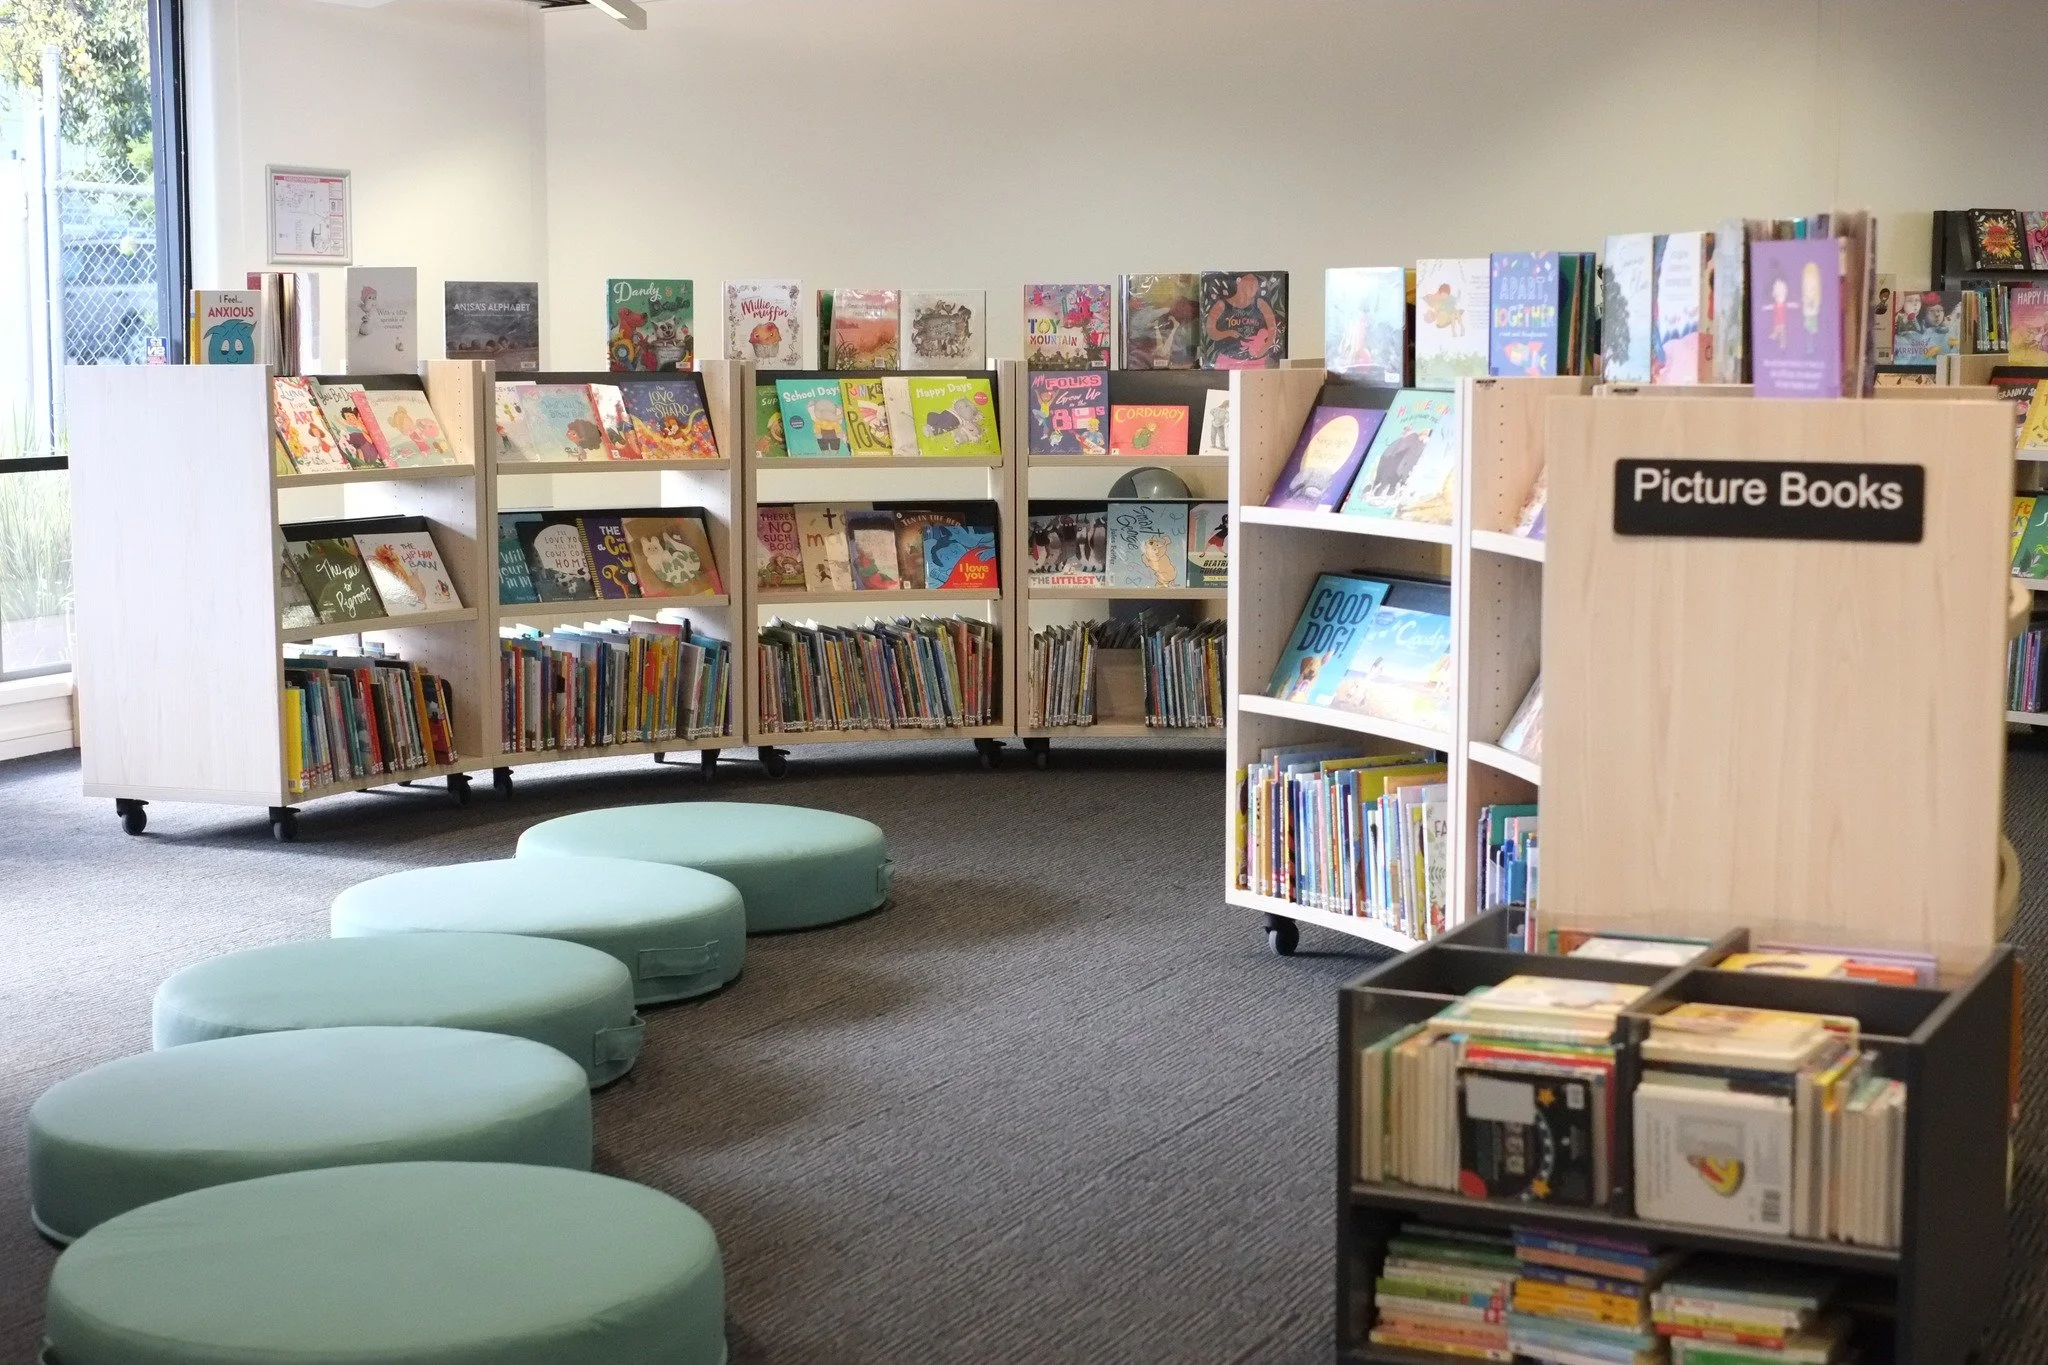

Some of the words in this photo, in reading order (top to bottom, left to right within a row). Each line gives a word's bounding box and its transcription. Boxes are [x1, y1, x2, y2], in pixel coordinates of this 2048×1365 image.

[613, 281, 662, 303] Dandy
[2017, 290, 2042, 305] HAPPY
[207, 306, 254, 318] ANXIOUS
[453, 303, 486, 311] ANISA'S
[488, 304, 531, 312] ALPHABET
[741, 299, 771, 315] Millie
[753, 306, 788, 322] muffin
[1027, 317, 1061, 335] TOY
[1046, 374, 1102, 391] FOLKS
[782, 389, 816, 403] School
[915, 387, 946, 400] Happy
[947, 382, 973, 395] Days
[293, 410, 315, 425] ART
[1114, 407, 1185, 425] CORDUROY
[1633, 466, 1768, 507] Picture
[1779, 470, 1904, 511] Books
[599, 526, 620, 536] THE
[768, 521, 793, 533] NO
[763, 534, 792, 543] SUCH
[545, 550, 567, 558] COWS
[315, 558, 342, 581] The
[409, 560, 438, 571] BARN
[555, 559, 588, 568] HOME
[966, 562, 989, 573] love
[965, 572, 985, 586] you
[1030, 576, 1050, 585] THE
[1051, 576, 1096, 585] LITTLEST
[1310, 588, 1373, 626] GOOD
[1296, 621, 1357, 660] DOG!
